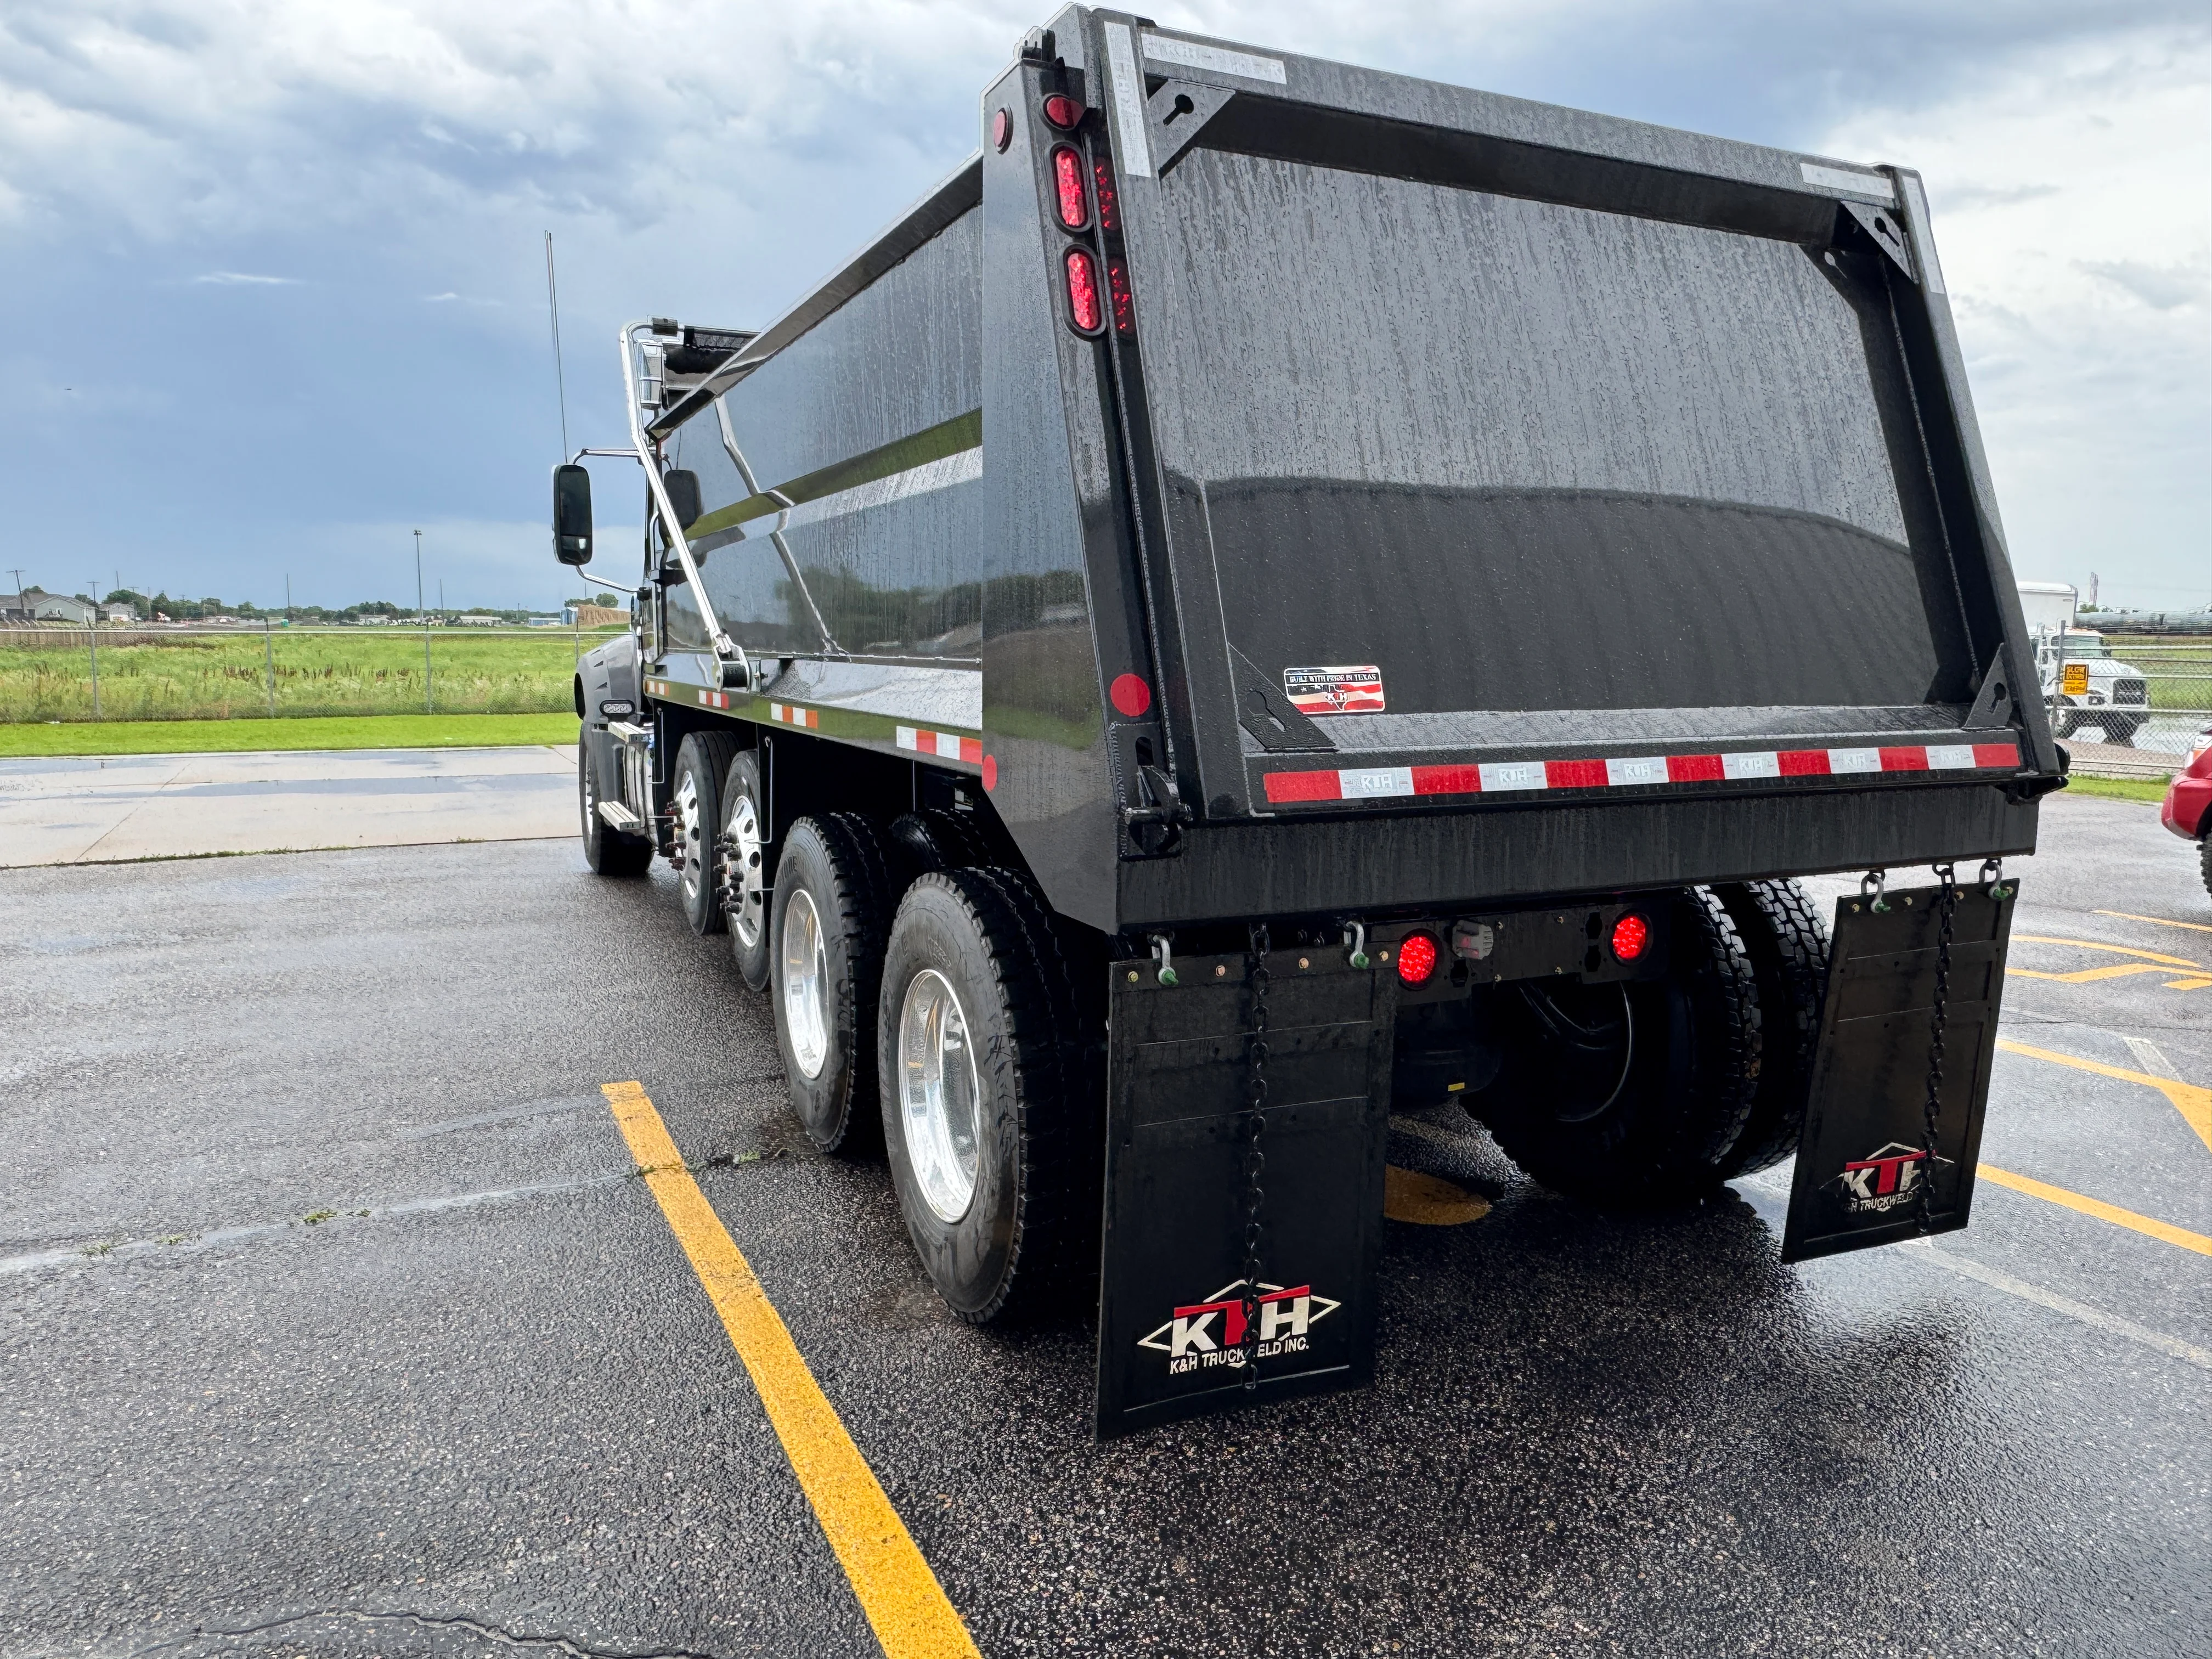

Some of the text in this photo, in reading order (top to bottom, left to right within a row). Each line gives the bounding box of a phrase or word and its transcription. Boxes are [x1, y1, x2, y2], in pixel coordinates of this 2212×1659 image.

[1353, 673, 1377, 681] TEXAS
[1170, 1336, 1310, 1375] K&H TRUCKELD INC.
